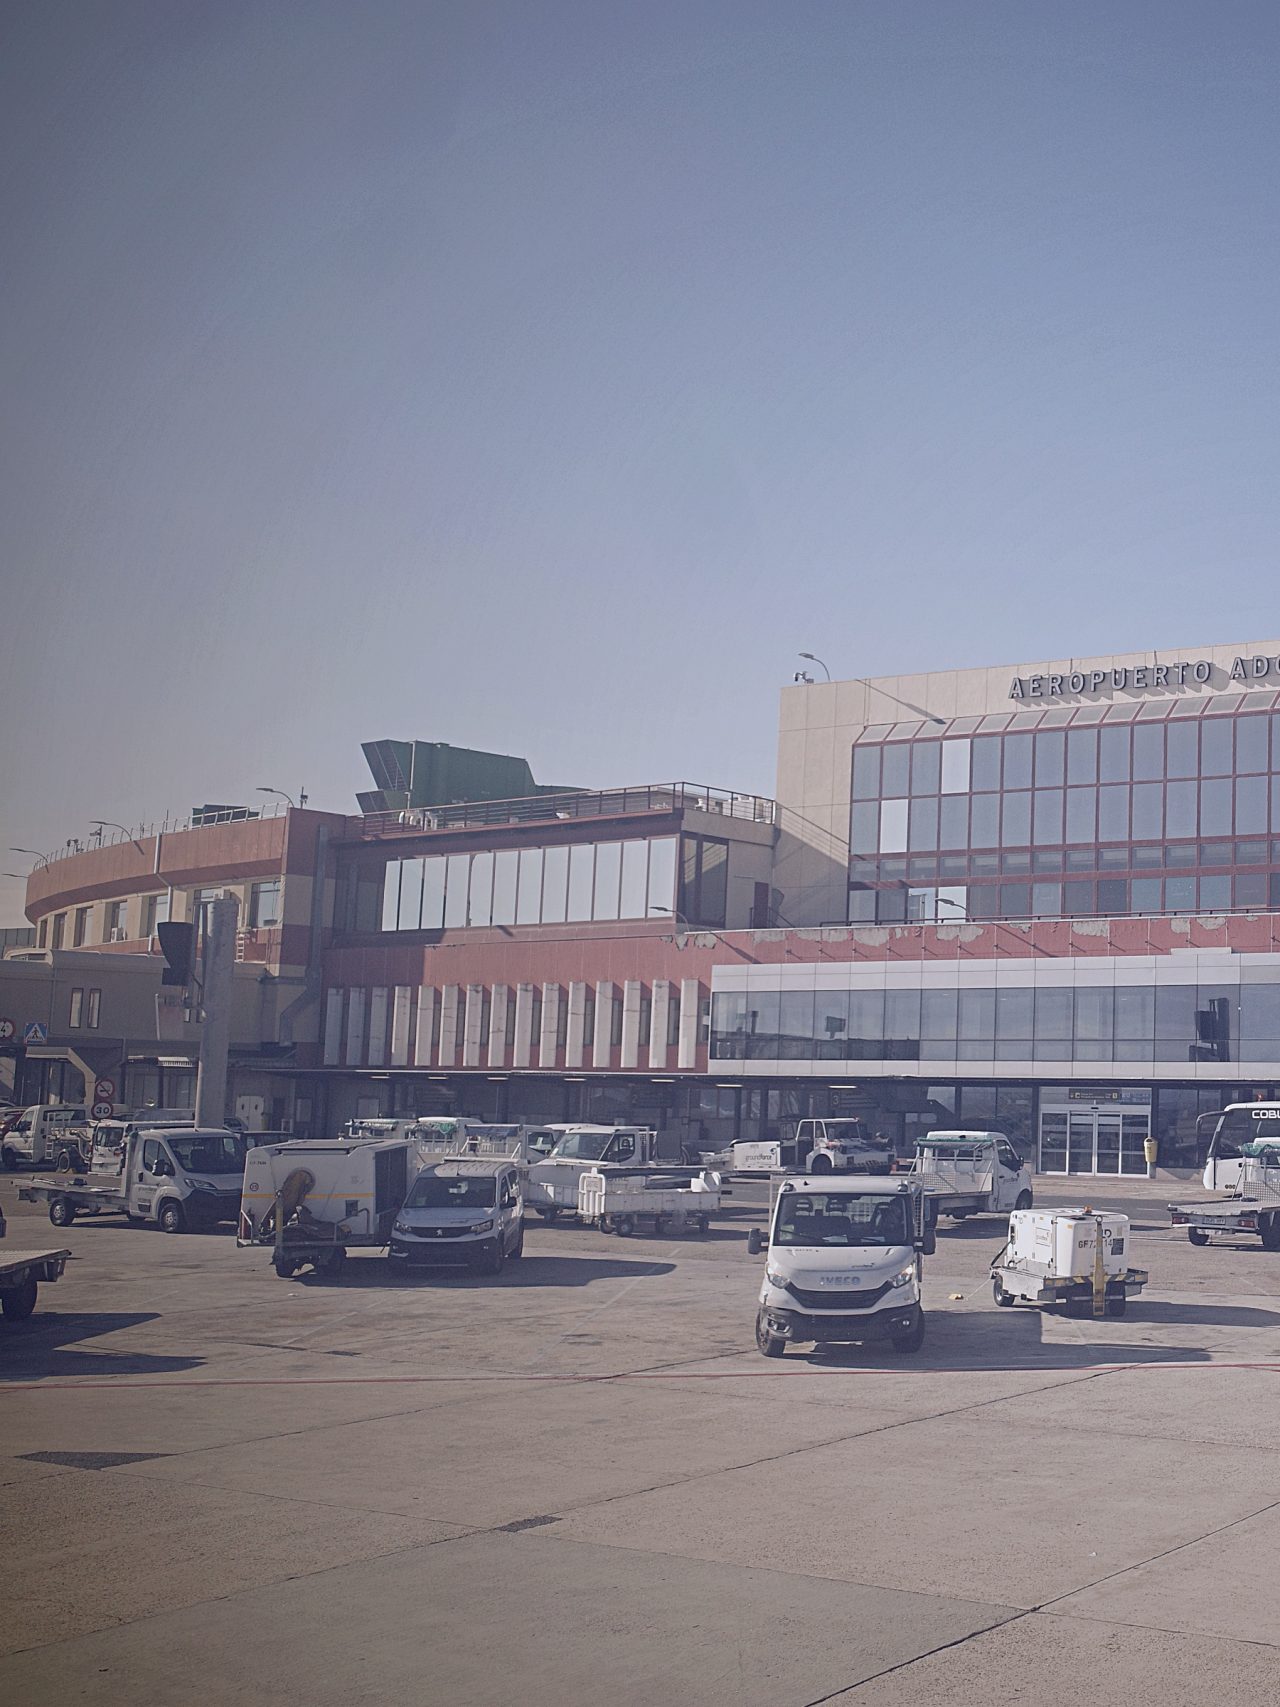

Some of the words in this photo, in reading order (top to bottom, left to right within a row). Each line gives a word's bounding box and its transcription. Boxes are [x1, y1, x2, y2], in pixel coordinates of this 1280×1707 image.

[1009, 660, 1212, 699] AEROPUERTO
[832, 1095, 840, 1105] 3
[96, 1106, 110, 1114] 30
[745, 1153, 772, 1162] groundforce
[1078, 1238, 1113, 1249] GF7214
[820, 1276, 861, 1286] IVECO
